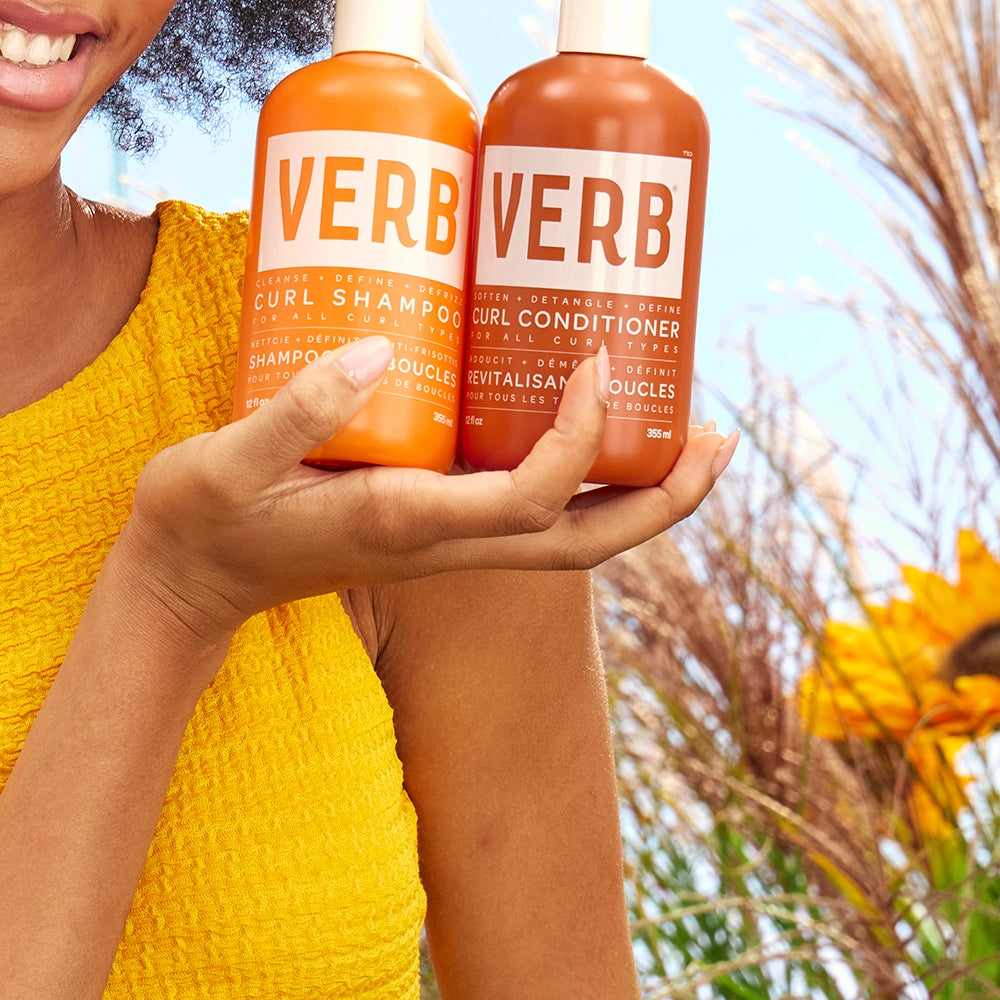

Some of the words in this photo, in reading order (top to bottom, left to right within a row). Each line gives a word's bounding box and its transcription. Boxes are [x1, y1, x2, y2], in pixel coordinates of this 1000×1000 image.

[279, 156, 458, 255] VERB
[493, 171, 674, 269] VERB
[256, 274, 308, 287] CLEANSE
[335, 274, 393, 287] DEFINE
[419, 284, 463, 306] DEFRIZZ
[474, 292, 509, 302] SOFTEN
[531, 295, 613, 309] DETANGLE
[639, 303, 681, 315] DEFINE
[254, 289, 314, 311] CURL
[332, 288, 461, 329] SHAMPOO
[472, 307, 510, 326] CURL
[518, 309, 680, 339] CONDITIONER
[252, 313, 277, 326] FOR
[292, 312, 327, 321] ALL
[347, 313, 400, 328] CURL
[418, 322, 460, 344] TYPES
[471, 331, 491, 340] FOR
[503, 333, 534, 343] ALL
[627, 341, 678, 354] TYPES
[249, 350, 333, 370] SHAMPO
[250, 335, 290, 348] NETTOIE
[391, 341, 458, 368] TI-FRISOTTIS
[469, 355, 513, 365] ADOUCIT
[537, 357, 579, 370] DÉMÊ
[626, 365, 677, 377] DÉFINIT
[247, 373, 270, 385] POUR
[395, 379, 410, 389] DE
[416, 383, 456, 403] BOUCLES
[468, 370, 567, 391] REVITALISAN
[609, 379, 675, 399] OUCLES
[489, 393, 516, 403] TOUS
[522, 395, 545, 405] LES
[626, 402, 674, 414] BOUCLES
